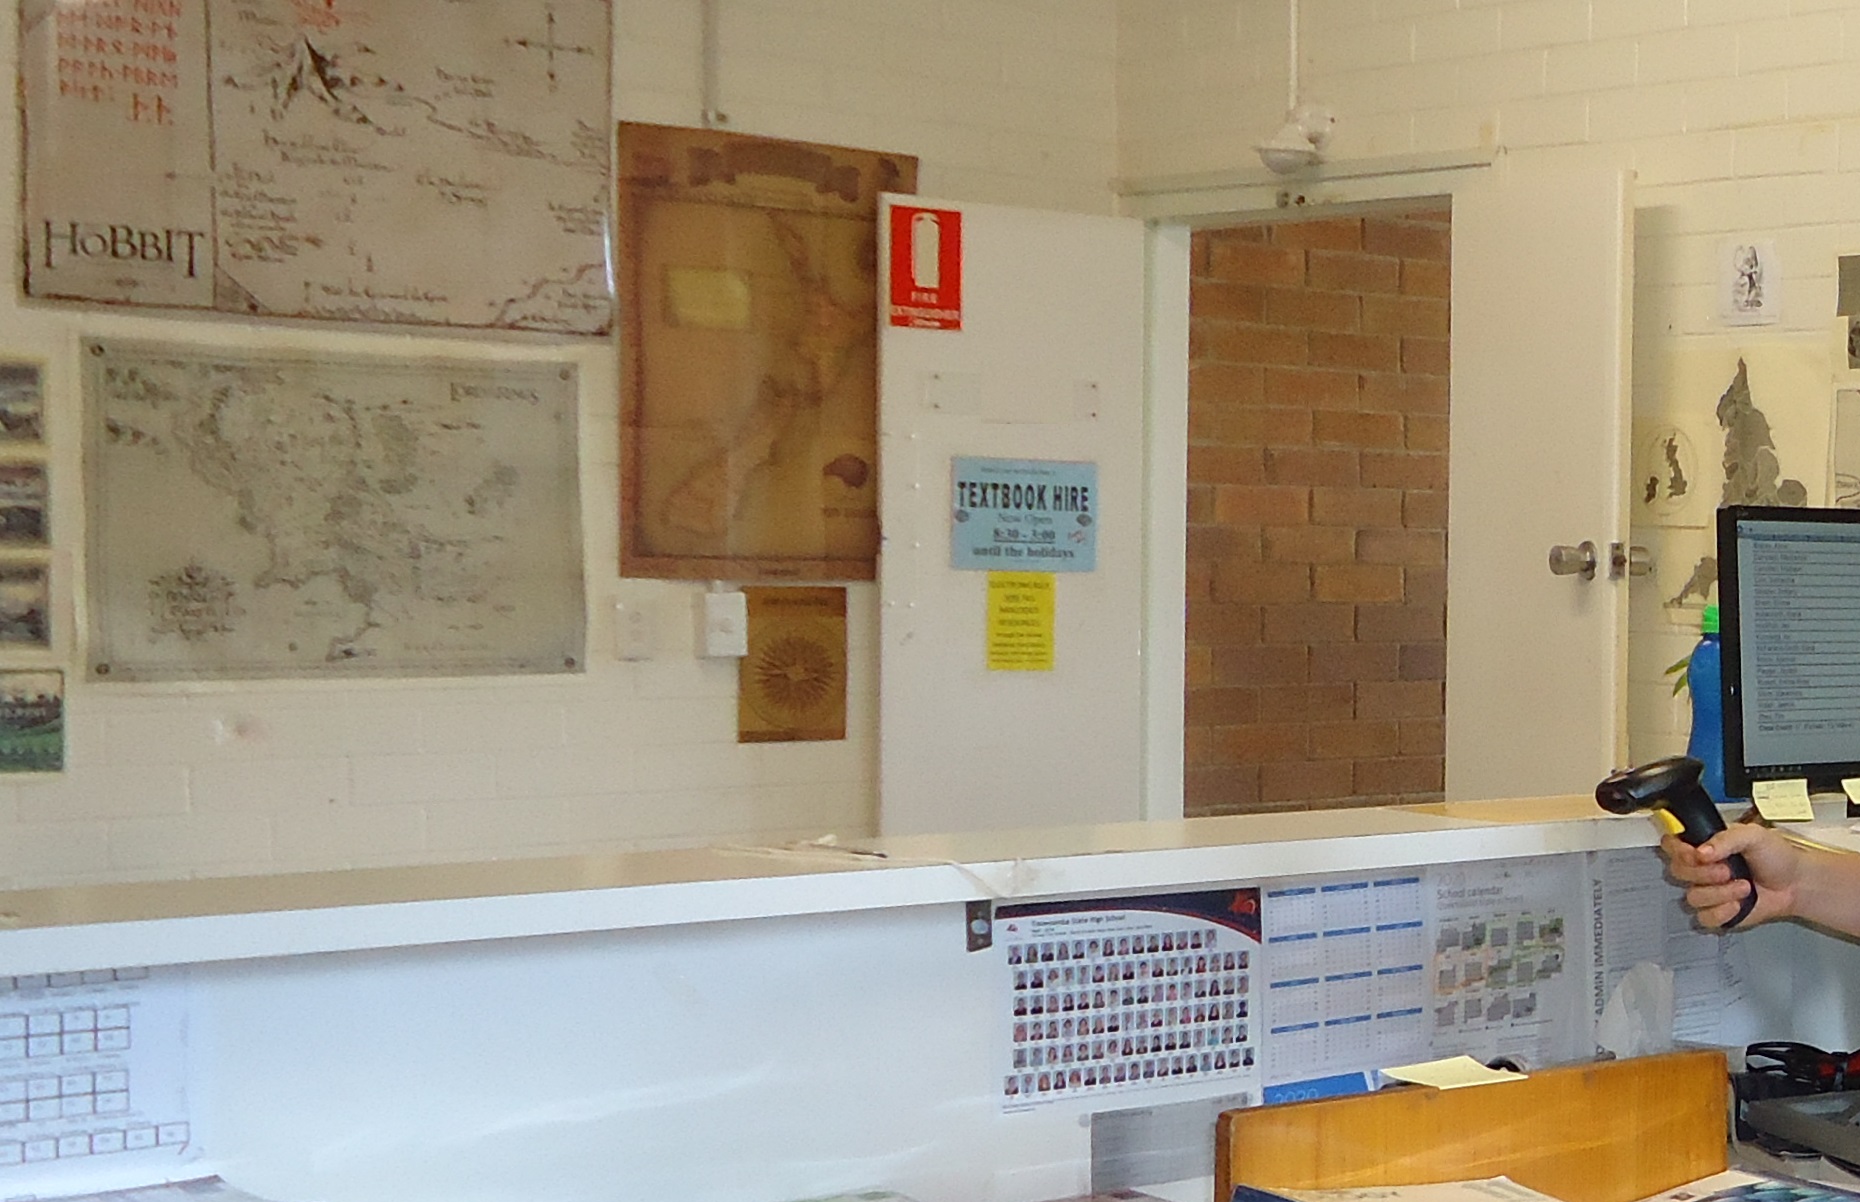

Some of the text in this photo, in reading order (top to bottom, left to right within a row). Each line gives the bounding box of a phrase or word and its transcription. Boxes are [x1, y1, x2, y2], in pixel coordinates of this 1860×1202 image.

[957, 481, 1090, 513] TEXTBOOK HIRE
[998, 513, 1053, 525] Now Open
[972, 546, 1075, 559] until the holidays
[1436, 885, 1504, 900] School calendar
[1592, 878, 1605, 1016] ADMIN IMMEDIATELY
